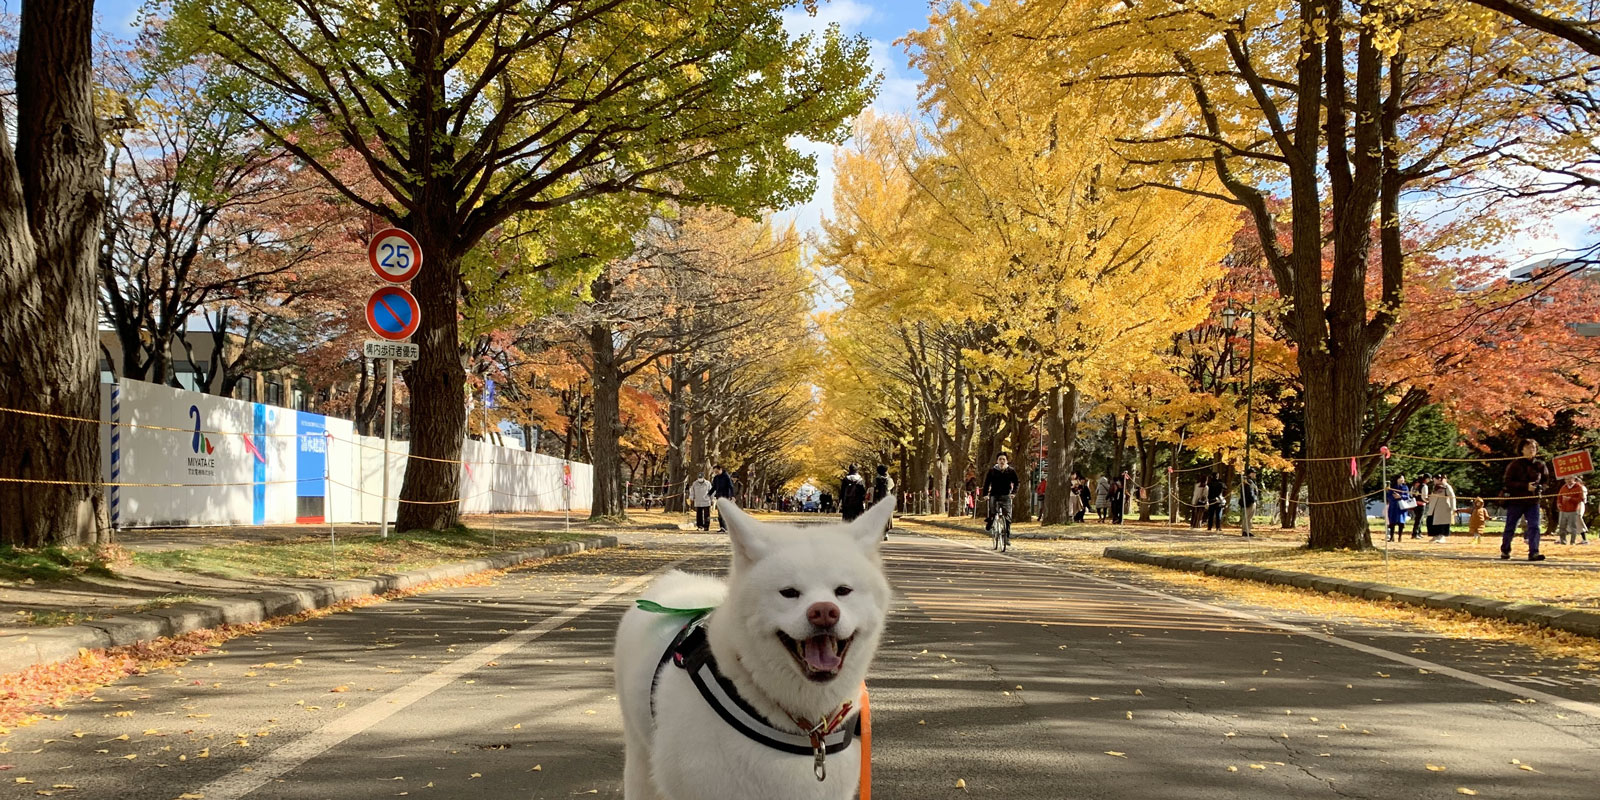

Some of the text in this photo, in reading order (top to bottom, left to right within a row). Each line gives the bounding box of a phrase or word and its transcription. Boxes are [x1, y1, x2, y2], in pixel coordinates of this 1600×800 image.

[381, 243, 409, 268] 25
[366, 343, 417, 358] 構内歩行者優先
[187, 457, 215, 468] MIYATAKE
